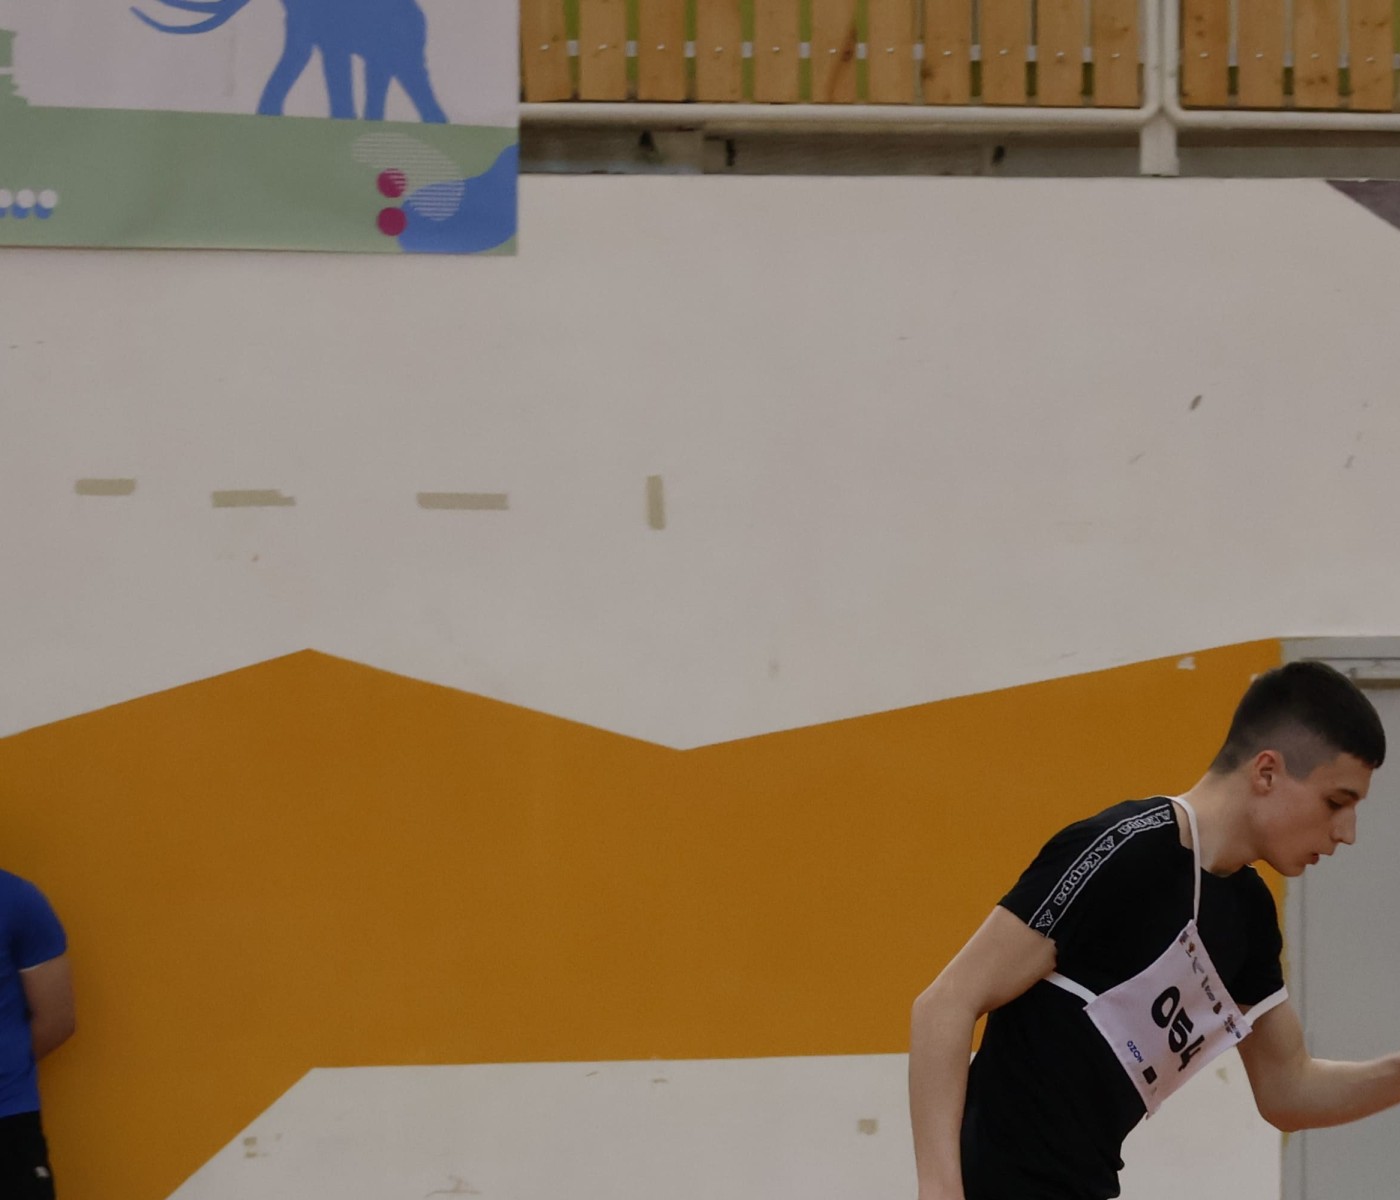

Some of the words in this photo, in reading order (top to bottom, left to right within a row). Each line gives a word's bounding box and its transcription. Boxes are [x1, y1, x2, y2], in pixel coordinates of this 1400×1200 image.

[1053, 853, 1101, 906] Kappa
[1126, 1039, 1144, 1063] OZON
[1151, 985, 1205, 1072] 054
